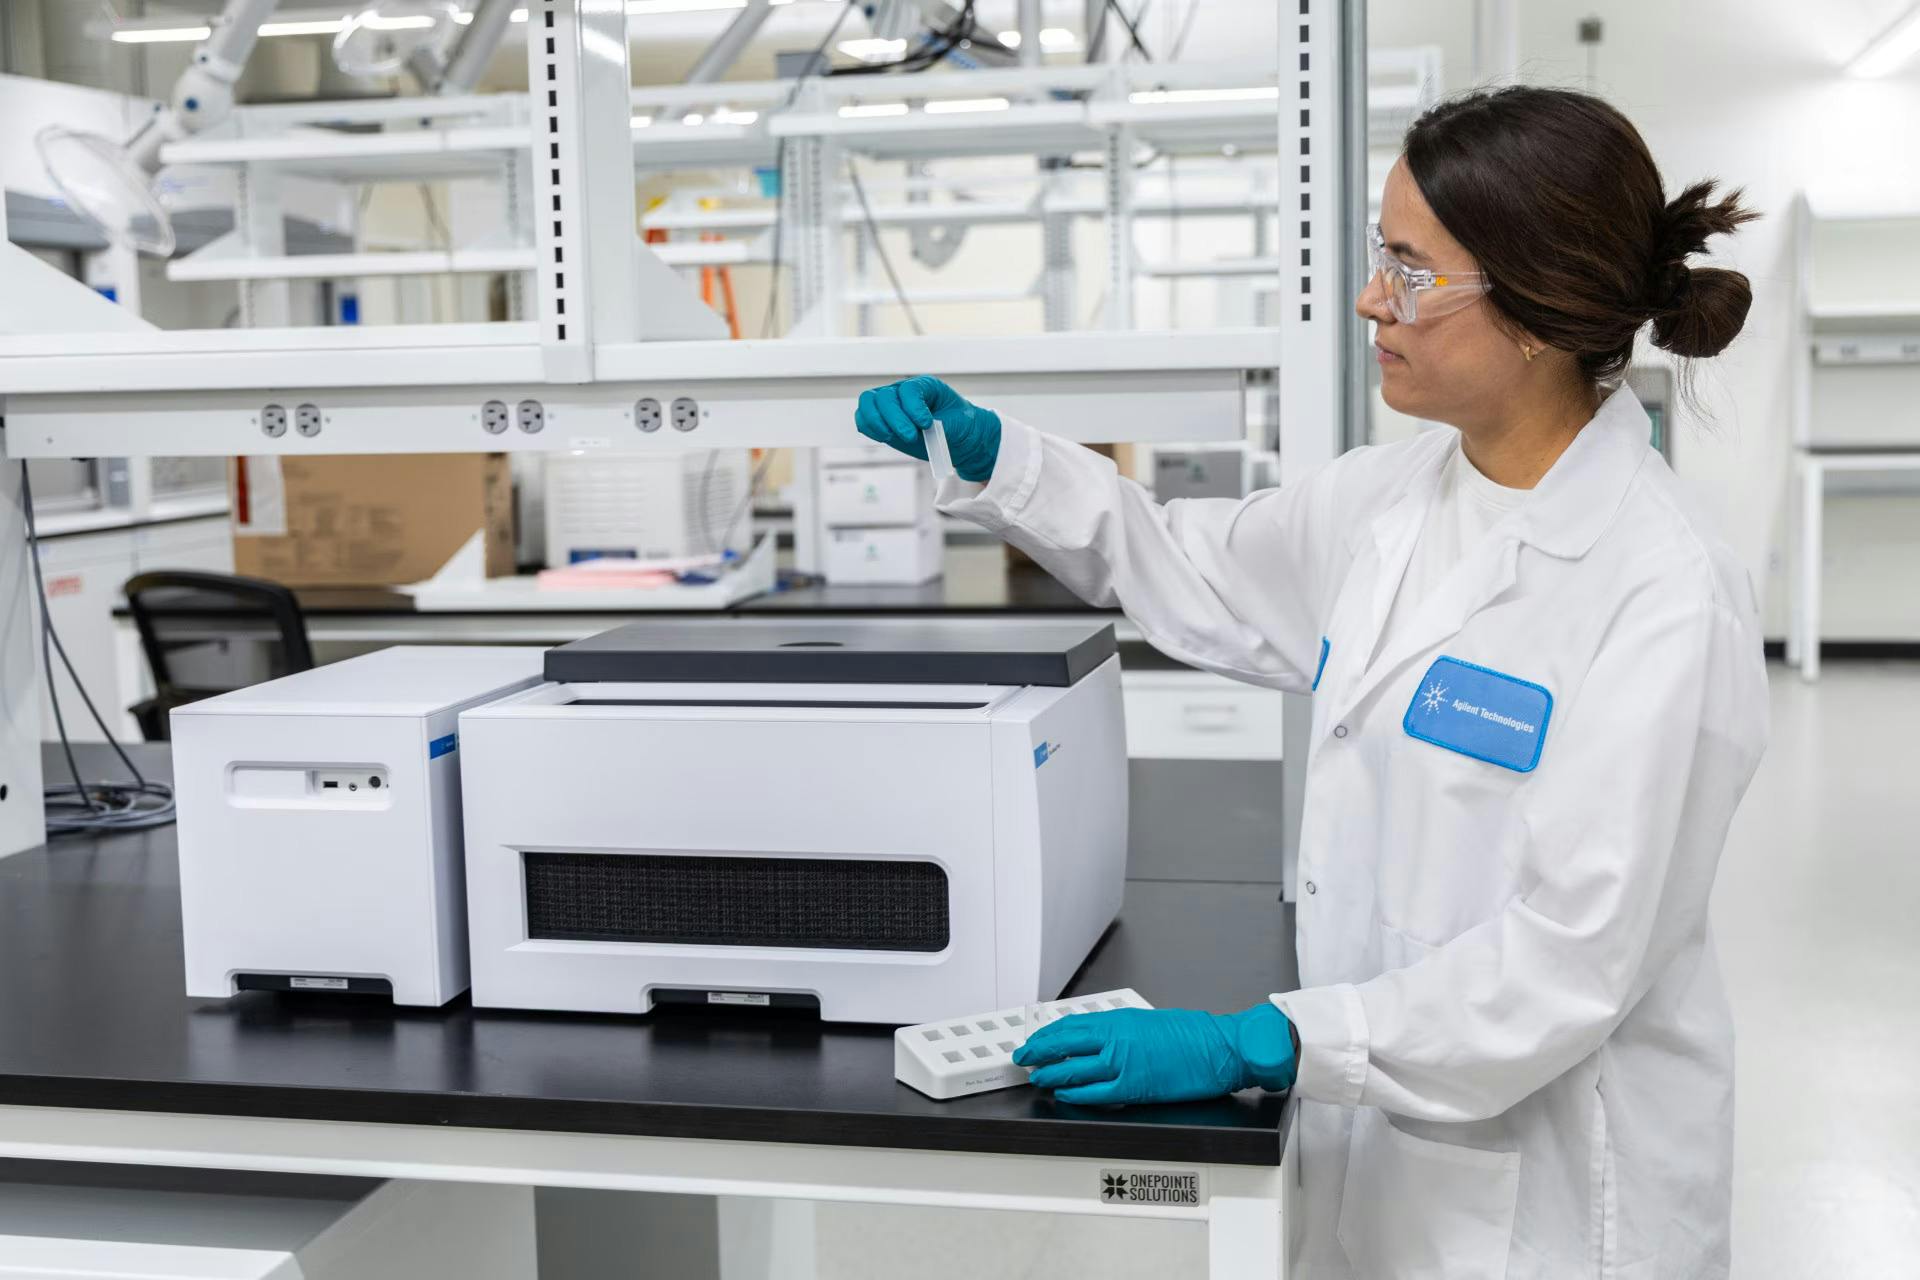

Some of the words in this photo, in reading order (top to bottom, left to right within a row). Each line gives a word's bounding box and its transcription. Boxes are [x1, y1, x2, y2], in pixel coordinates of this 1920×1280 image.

[1451, 699, 1480, 715] Agilent
[1480, 708, 1535, 733] Technologies
[1130, 1174, 1196, 1189] ONEPOINTE
[1129, 1188, 1198, 1203] SOLUTIONS
